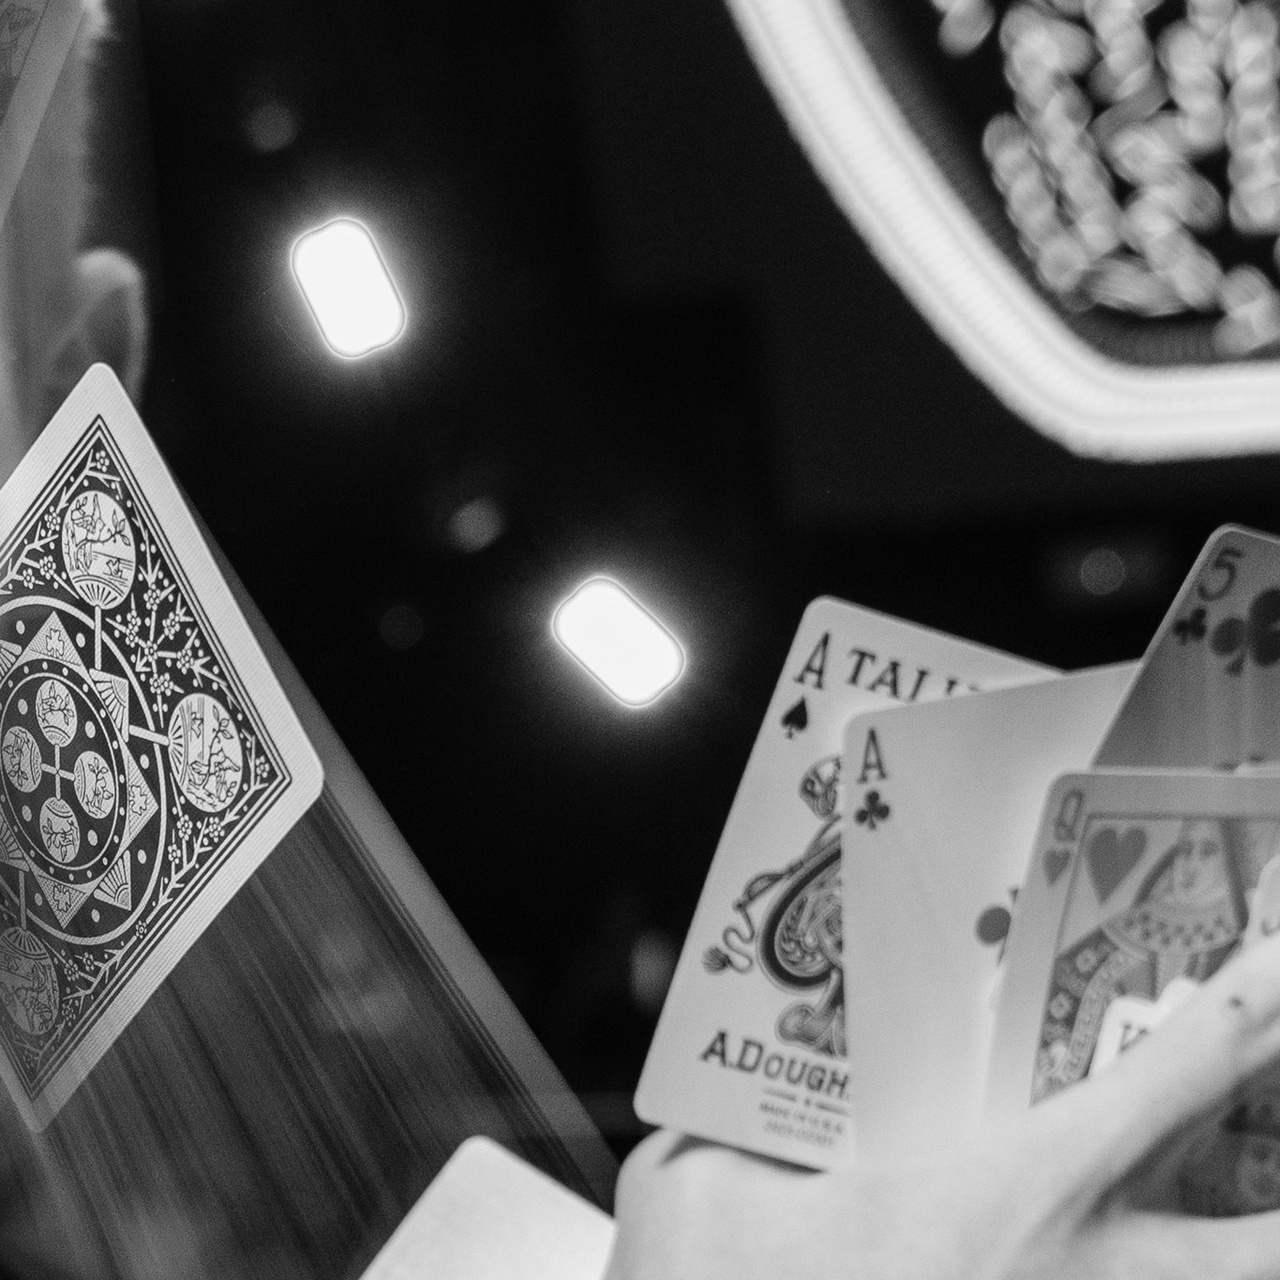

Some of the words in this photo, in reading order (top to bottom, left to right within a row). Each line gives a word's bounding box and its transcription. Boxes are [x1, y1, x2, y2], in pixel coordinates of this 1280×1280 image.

[1198, 546, 1243, 600] 5
[793, 631, 831, 690] A
[857, 727, 888, 784] A
[1053, 789, 1084, 842] Q
